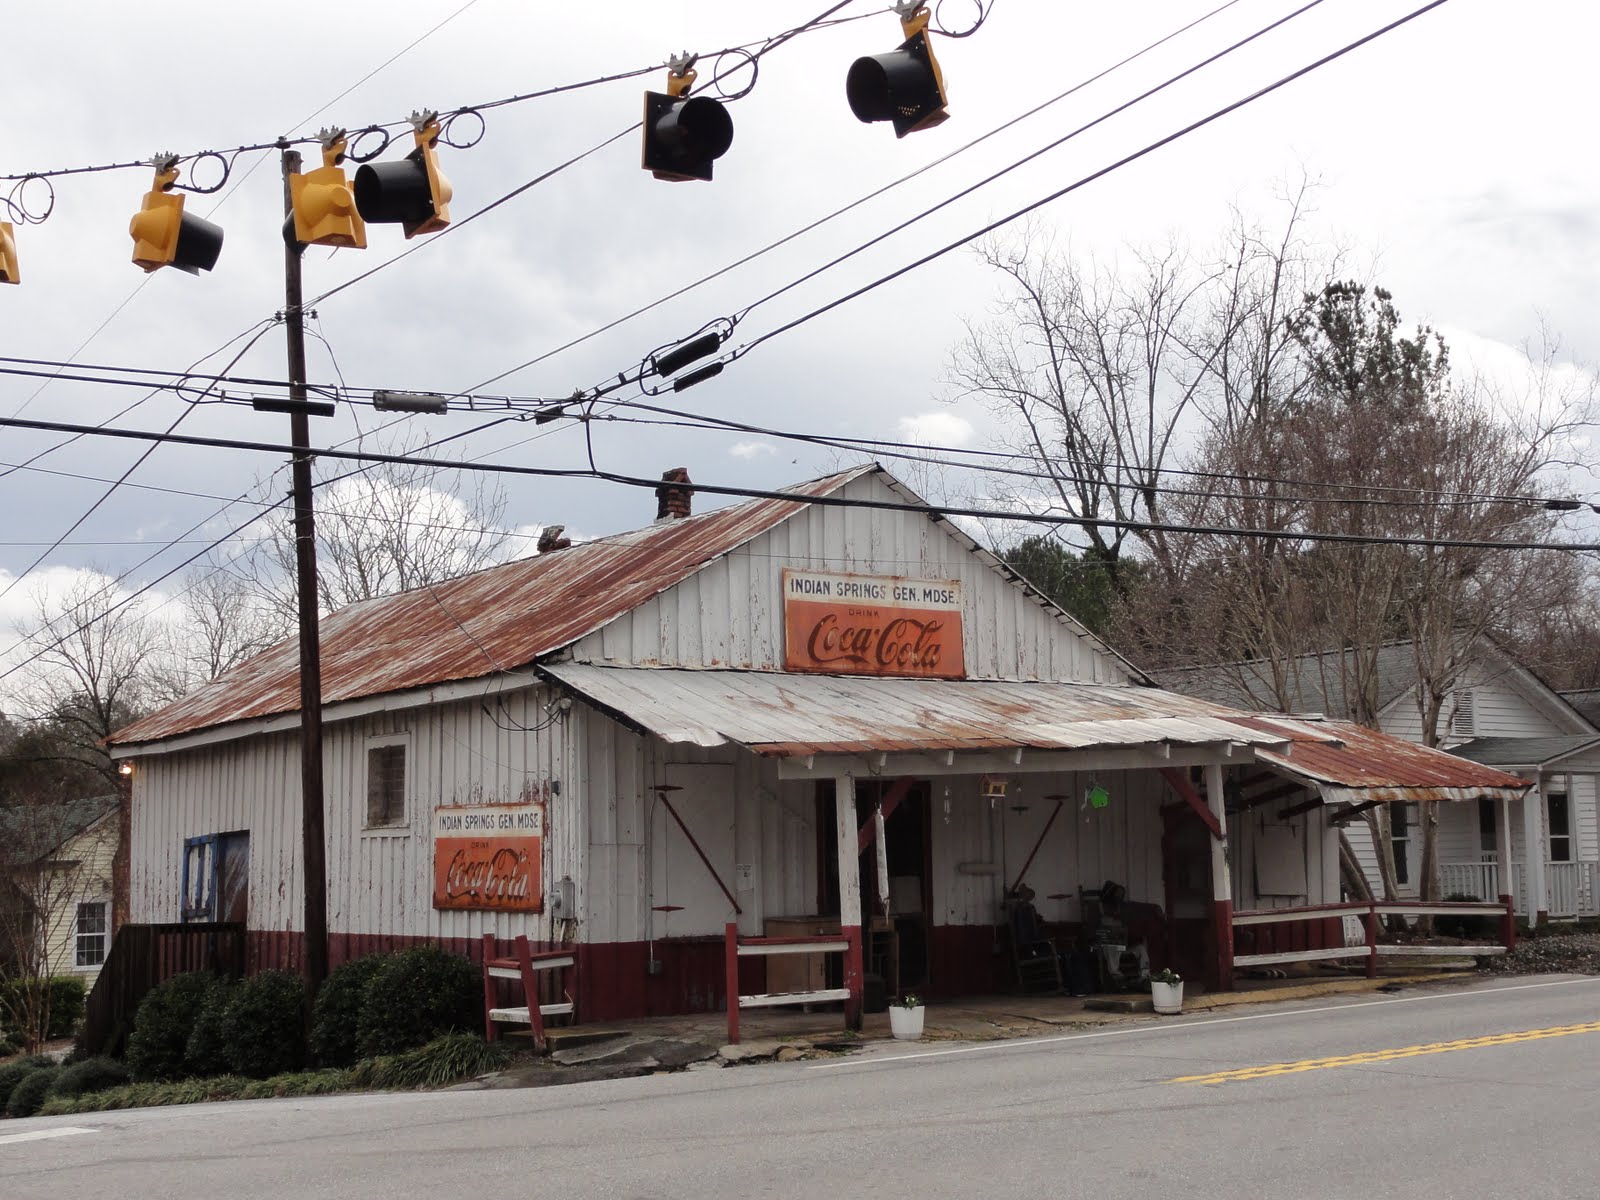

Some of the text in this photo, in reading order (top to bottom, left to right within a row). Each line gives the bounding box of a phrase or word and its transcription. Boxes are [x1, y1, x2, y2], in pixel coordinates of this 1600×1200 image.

[791, 578, 959, 604] INDIAN SPRINGS GEN. MDSE.
[848, 608, 880, 617] DRINK
[439, 815, 462, 830] INDIAN
[465, 814, 495, 830] SPRINGS
[498, 813, 517, 829] GEN.
